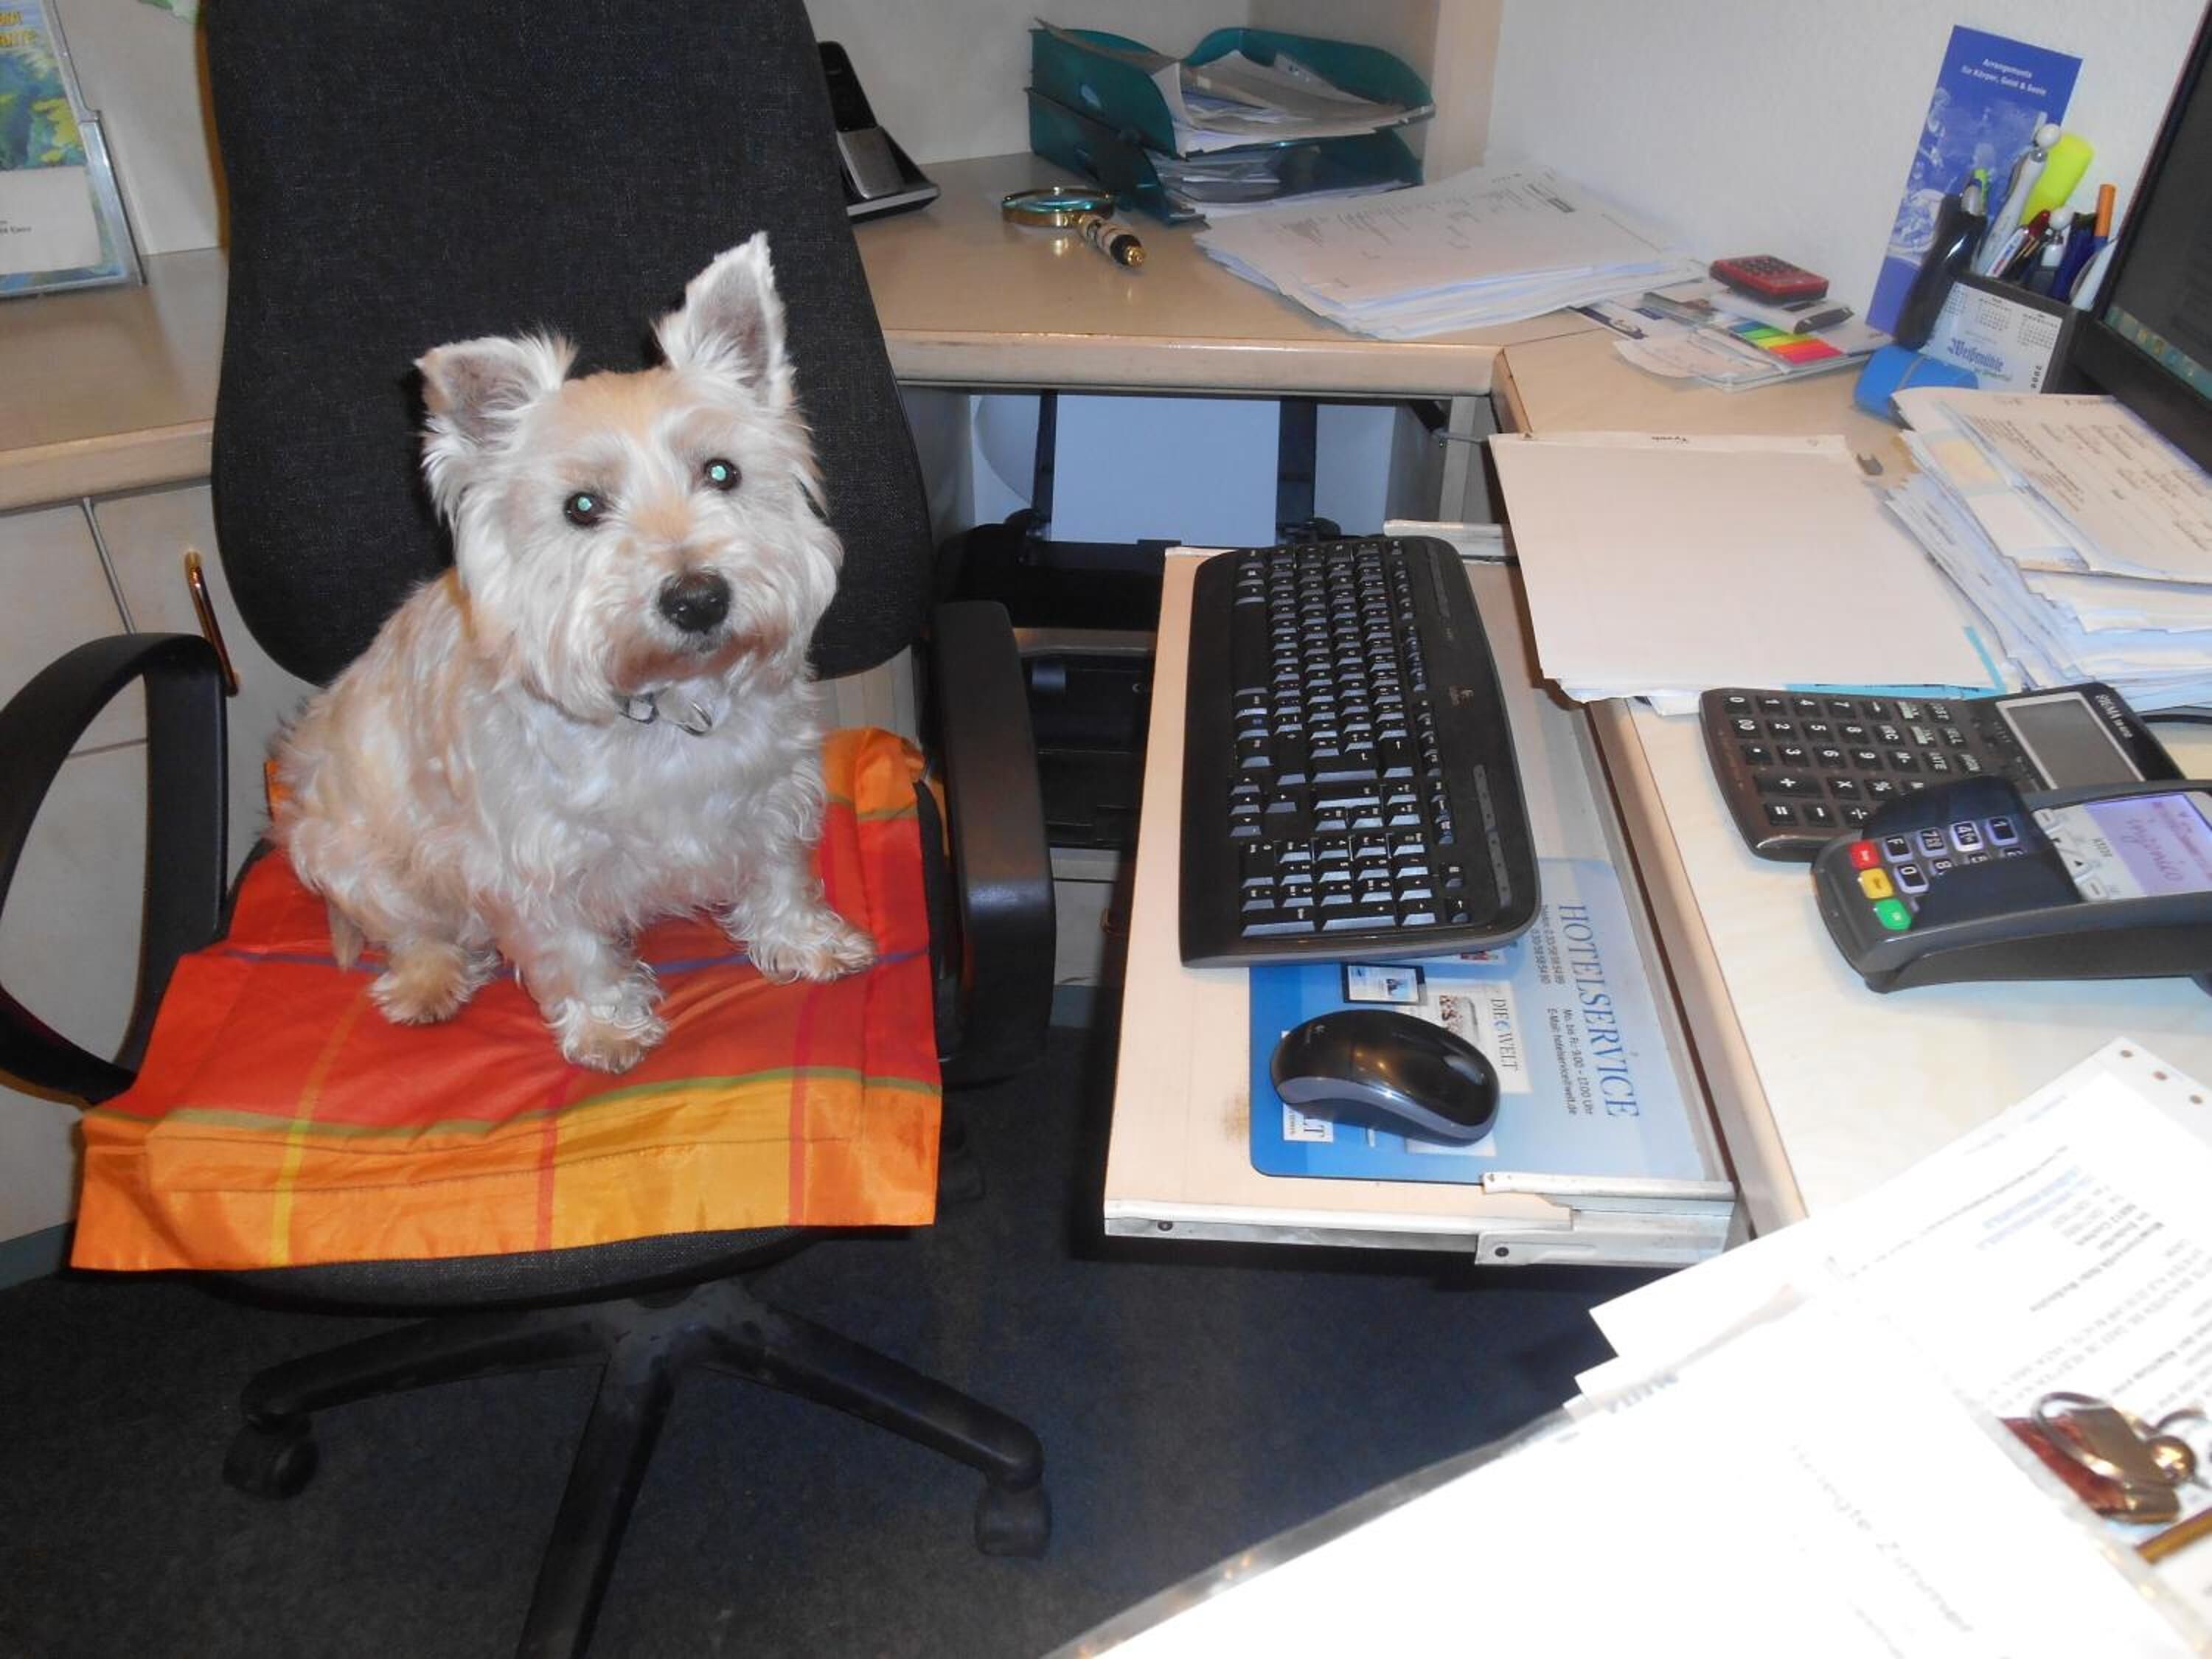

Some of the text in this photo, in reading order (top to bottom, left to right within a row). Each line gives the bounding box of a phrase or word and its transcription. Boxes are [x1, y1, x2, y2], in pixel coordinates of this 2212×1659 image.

[1738, 719, 1756, 731] 00
[1846, 726, 1863, 734] 8
[1785, 748, 1801, 756] 3
[1823, 750, 1839, 758] 6
[1859, 751, 1876, 759] 9
[1887, 838, 1905, 846] F
[1900, 866, 1917, 876] 0
[1935, 860, 1952, 869] 8
[1558, 905, 1640, 1116] HOTELSERVICE
[1489, 998, 1519, 1072] DIE WELT
